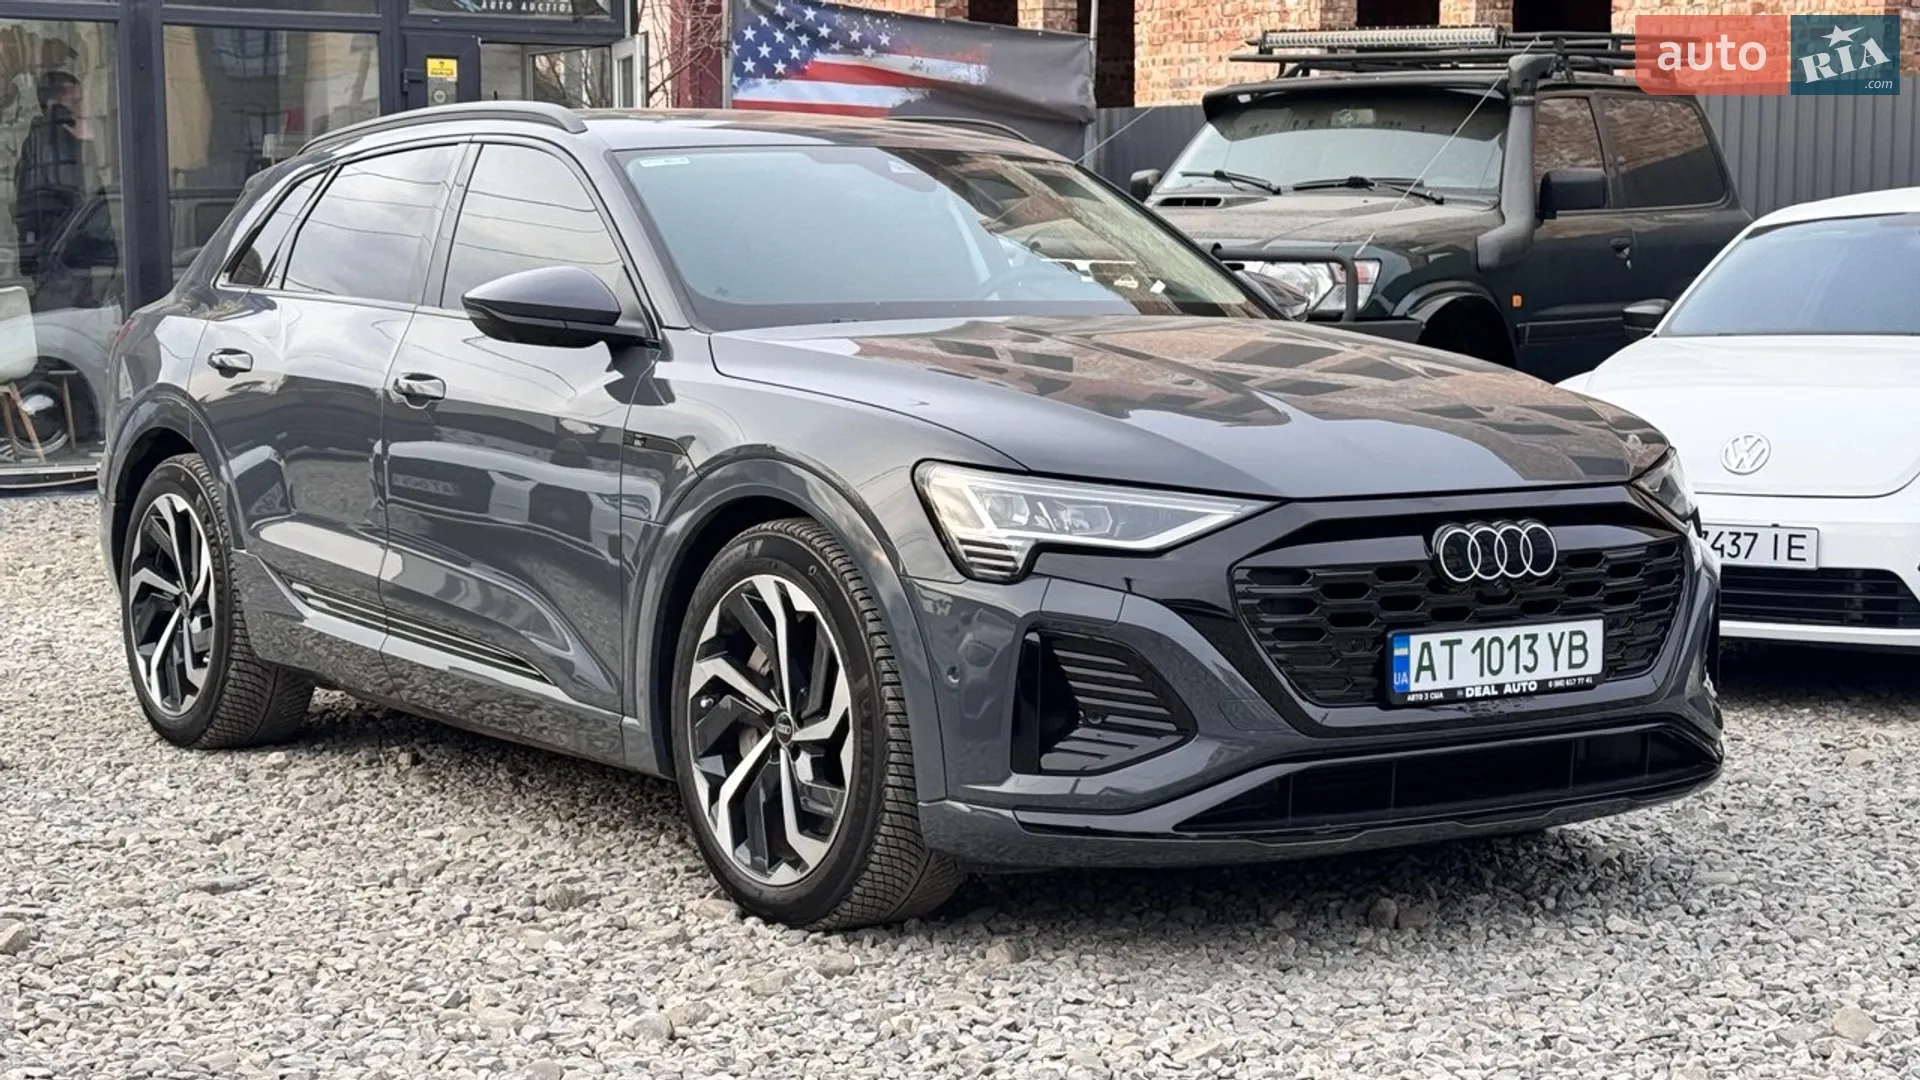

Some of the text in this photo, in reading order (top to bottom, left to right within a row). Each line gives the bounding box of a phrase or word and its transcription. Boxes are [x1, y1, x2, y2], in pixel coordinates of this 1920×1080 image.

[481, 1, 513, 10] AUTO
[1773, 533, 1807, 562] IE
[1414, 629, 1589, 684] AT 1013 YB
[1393, 672, 1409, 685] UA
[1465, 685, 1498, 698] DEAL
[1503, 680, 1538, 694] AUTO
